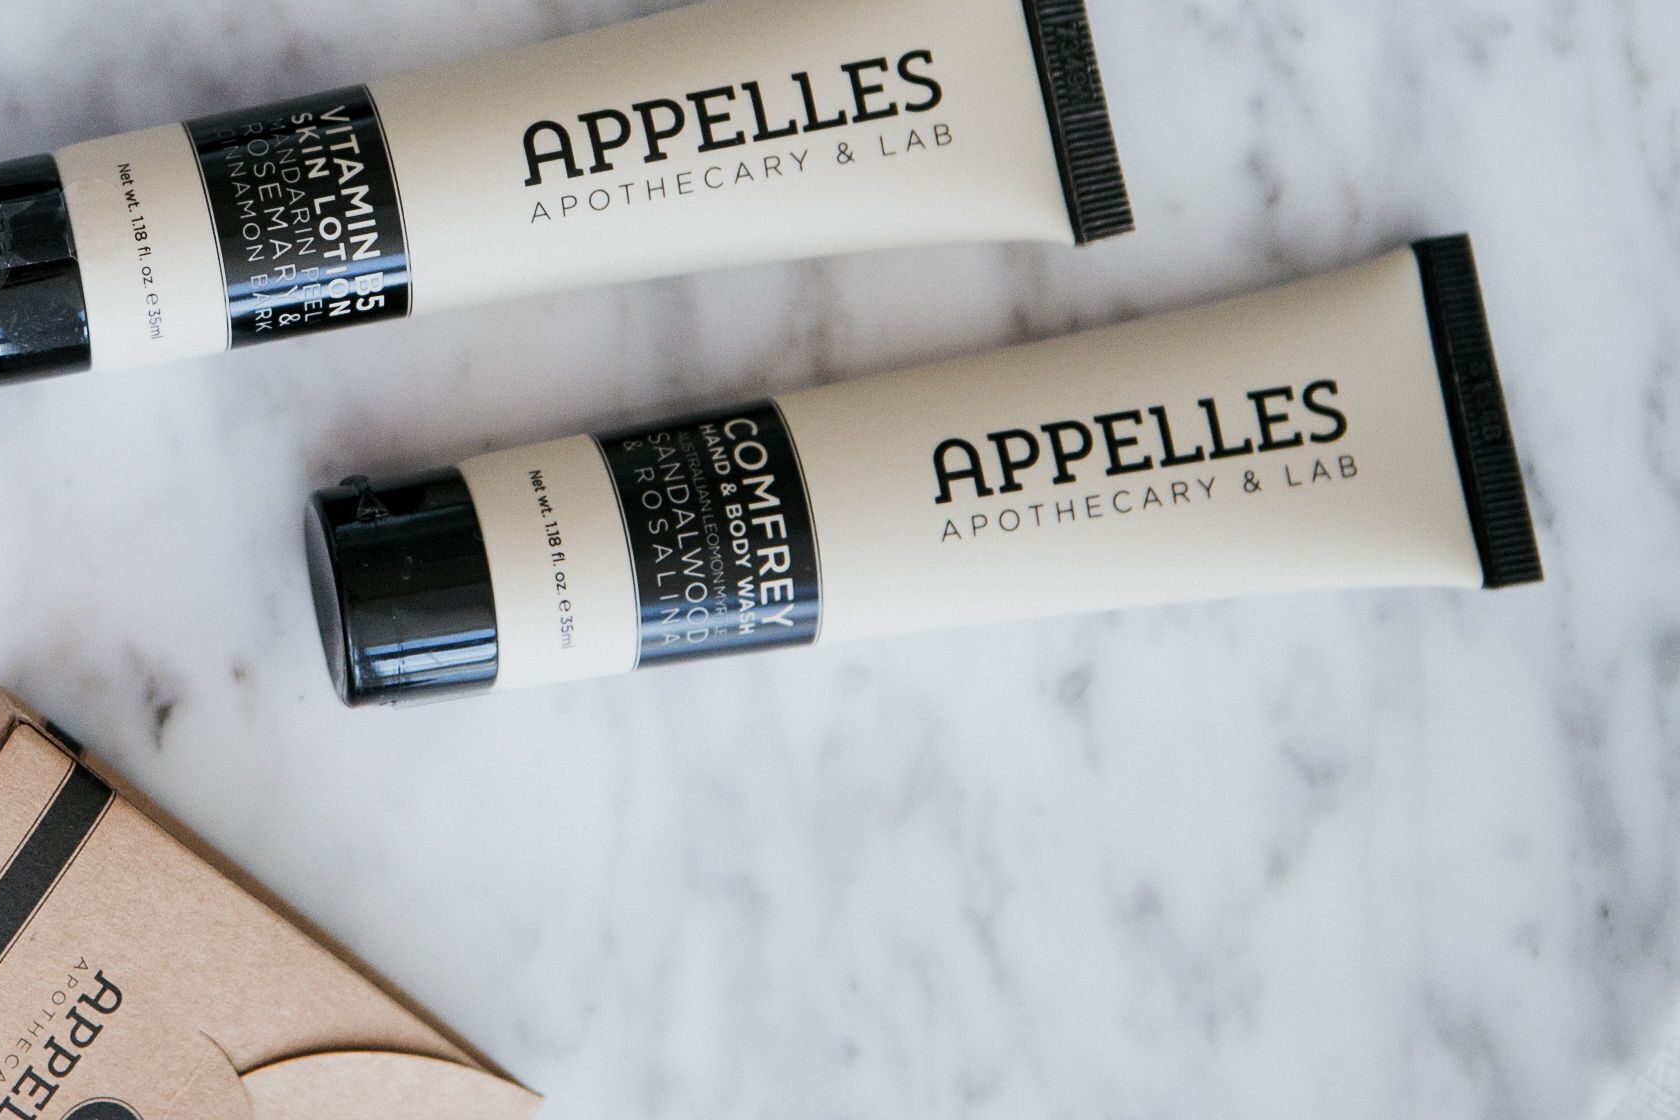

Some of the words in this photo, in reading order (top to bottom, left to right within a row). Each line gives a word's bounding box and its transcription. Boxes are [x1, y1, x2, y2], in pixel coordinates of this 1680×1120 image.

[522, 49, 944, 188] APPELLES
[117, 163, 134, 186] Net
[124, 189, 140, 212] wt.
[529, 149, 810, 224] APOTHECARY
[835, 141, 855, 165] &
[878, 122, 954, 158] LAB
[131, 215, 148, 242] 1.18
[216, 128, 265, 262] CINNAMON
[250, 274, 273, 332] BARK
[241, 122, 302, 299] ROSEMARY
[278, 313, 301, 327] &
[270, 118, 317, 256] MANDARIN
[300, 266, 323, 322] PEEL
[291, 112, 331, 179] SKIN
[313, 195, 351, 317] LOTION
[320, 105, 381, 261] VITAMIN
[354, 271, 385, 312] B5
[137, 246, 152, 261] fl.
[141, 266, 154, 289] oz.
[148, 308, 164, 340] 35ml
[699, 424, 731, 475] HAND
[932, 378, 1348, 505] APPELLES
[528, 469, 546, 492] Net
[537, 495, 553, 518] wt.
[720, 482, 738, 497] &
[940, 476, 1216, 543] APOTHECARY
[1242, 469, 1262, 494] &
[1284, 454, 1359, 487] LAB
[545, 521, 562, 547] 1.18
[623, 441, 643, 452] &
[635, 467, 682, 647] ROSALINA
[648, 432, 709, 644] SANDALWOOD
[724, 418, 795, 627] COMFREY
[725, 504, 752, 569] BODY
[551, 552, 566, 566] fl.
[555, 572, 567, 595] oz.
[737, 576, 756, 635] WASH
